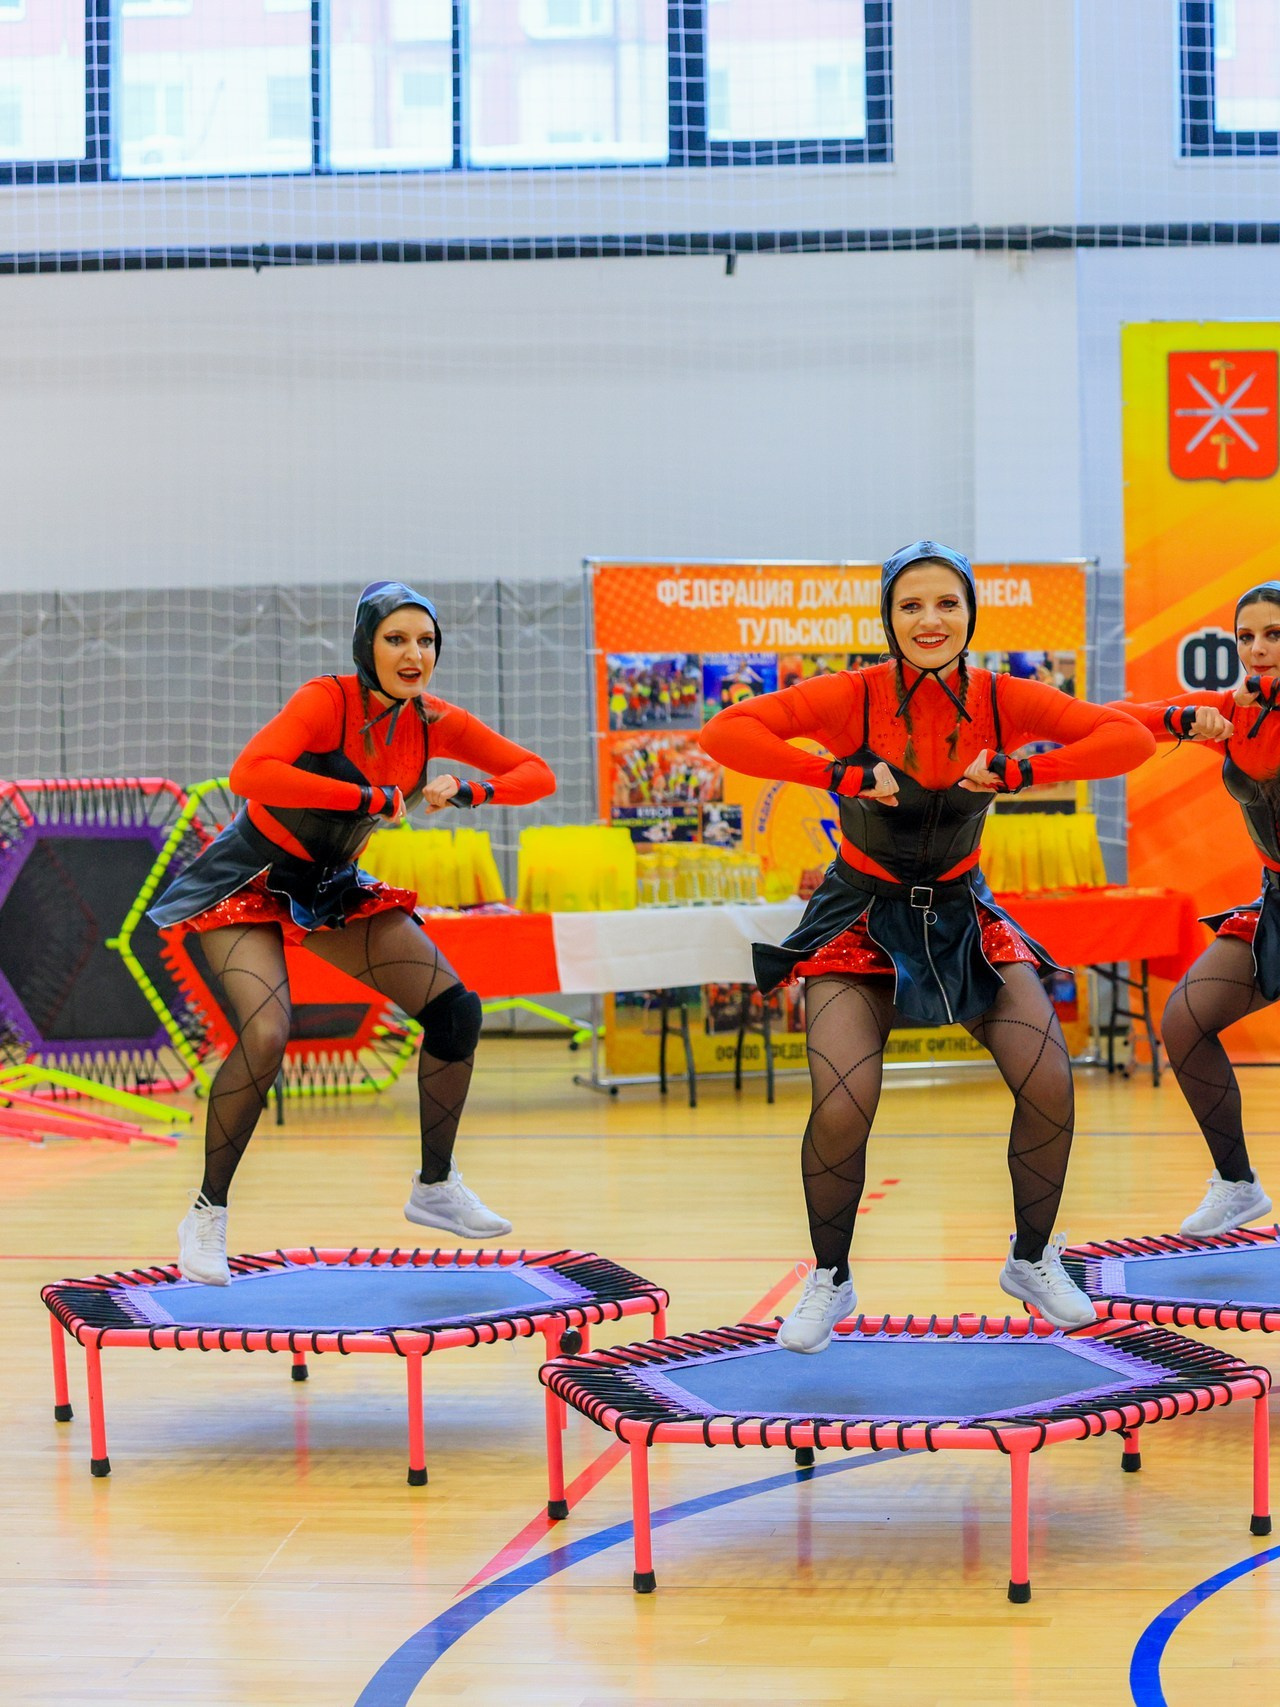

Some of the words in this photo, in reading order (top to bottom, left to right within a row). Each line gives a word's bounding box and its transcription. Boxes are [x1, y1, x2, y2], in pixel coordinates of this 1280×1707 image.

[656, 578, 794, 609] ФЕДЕРАЦИЯ
[797, 578, 883, 609] ДЖАМП
[737, 614, 853, 646] ТУЛЬСКОЙ
